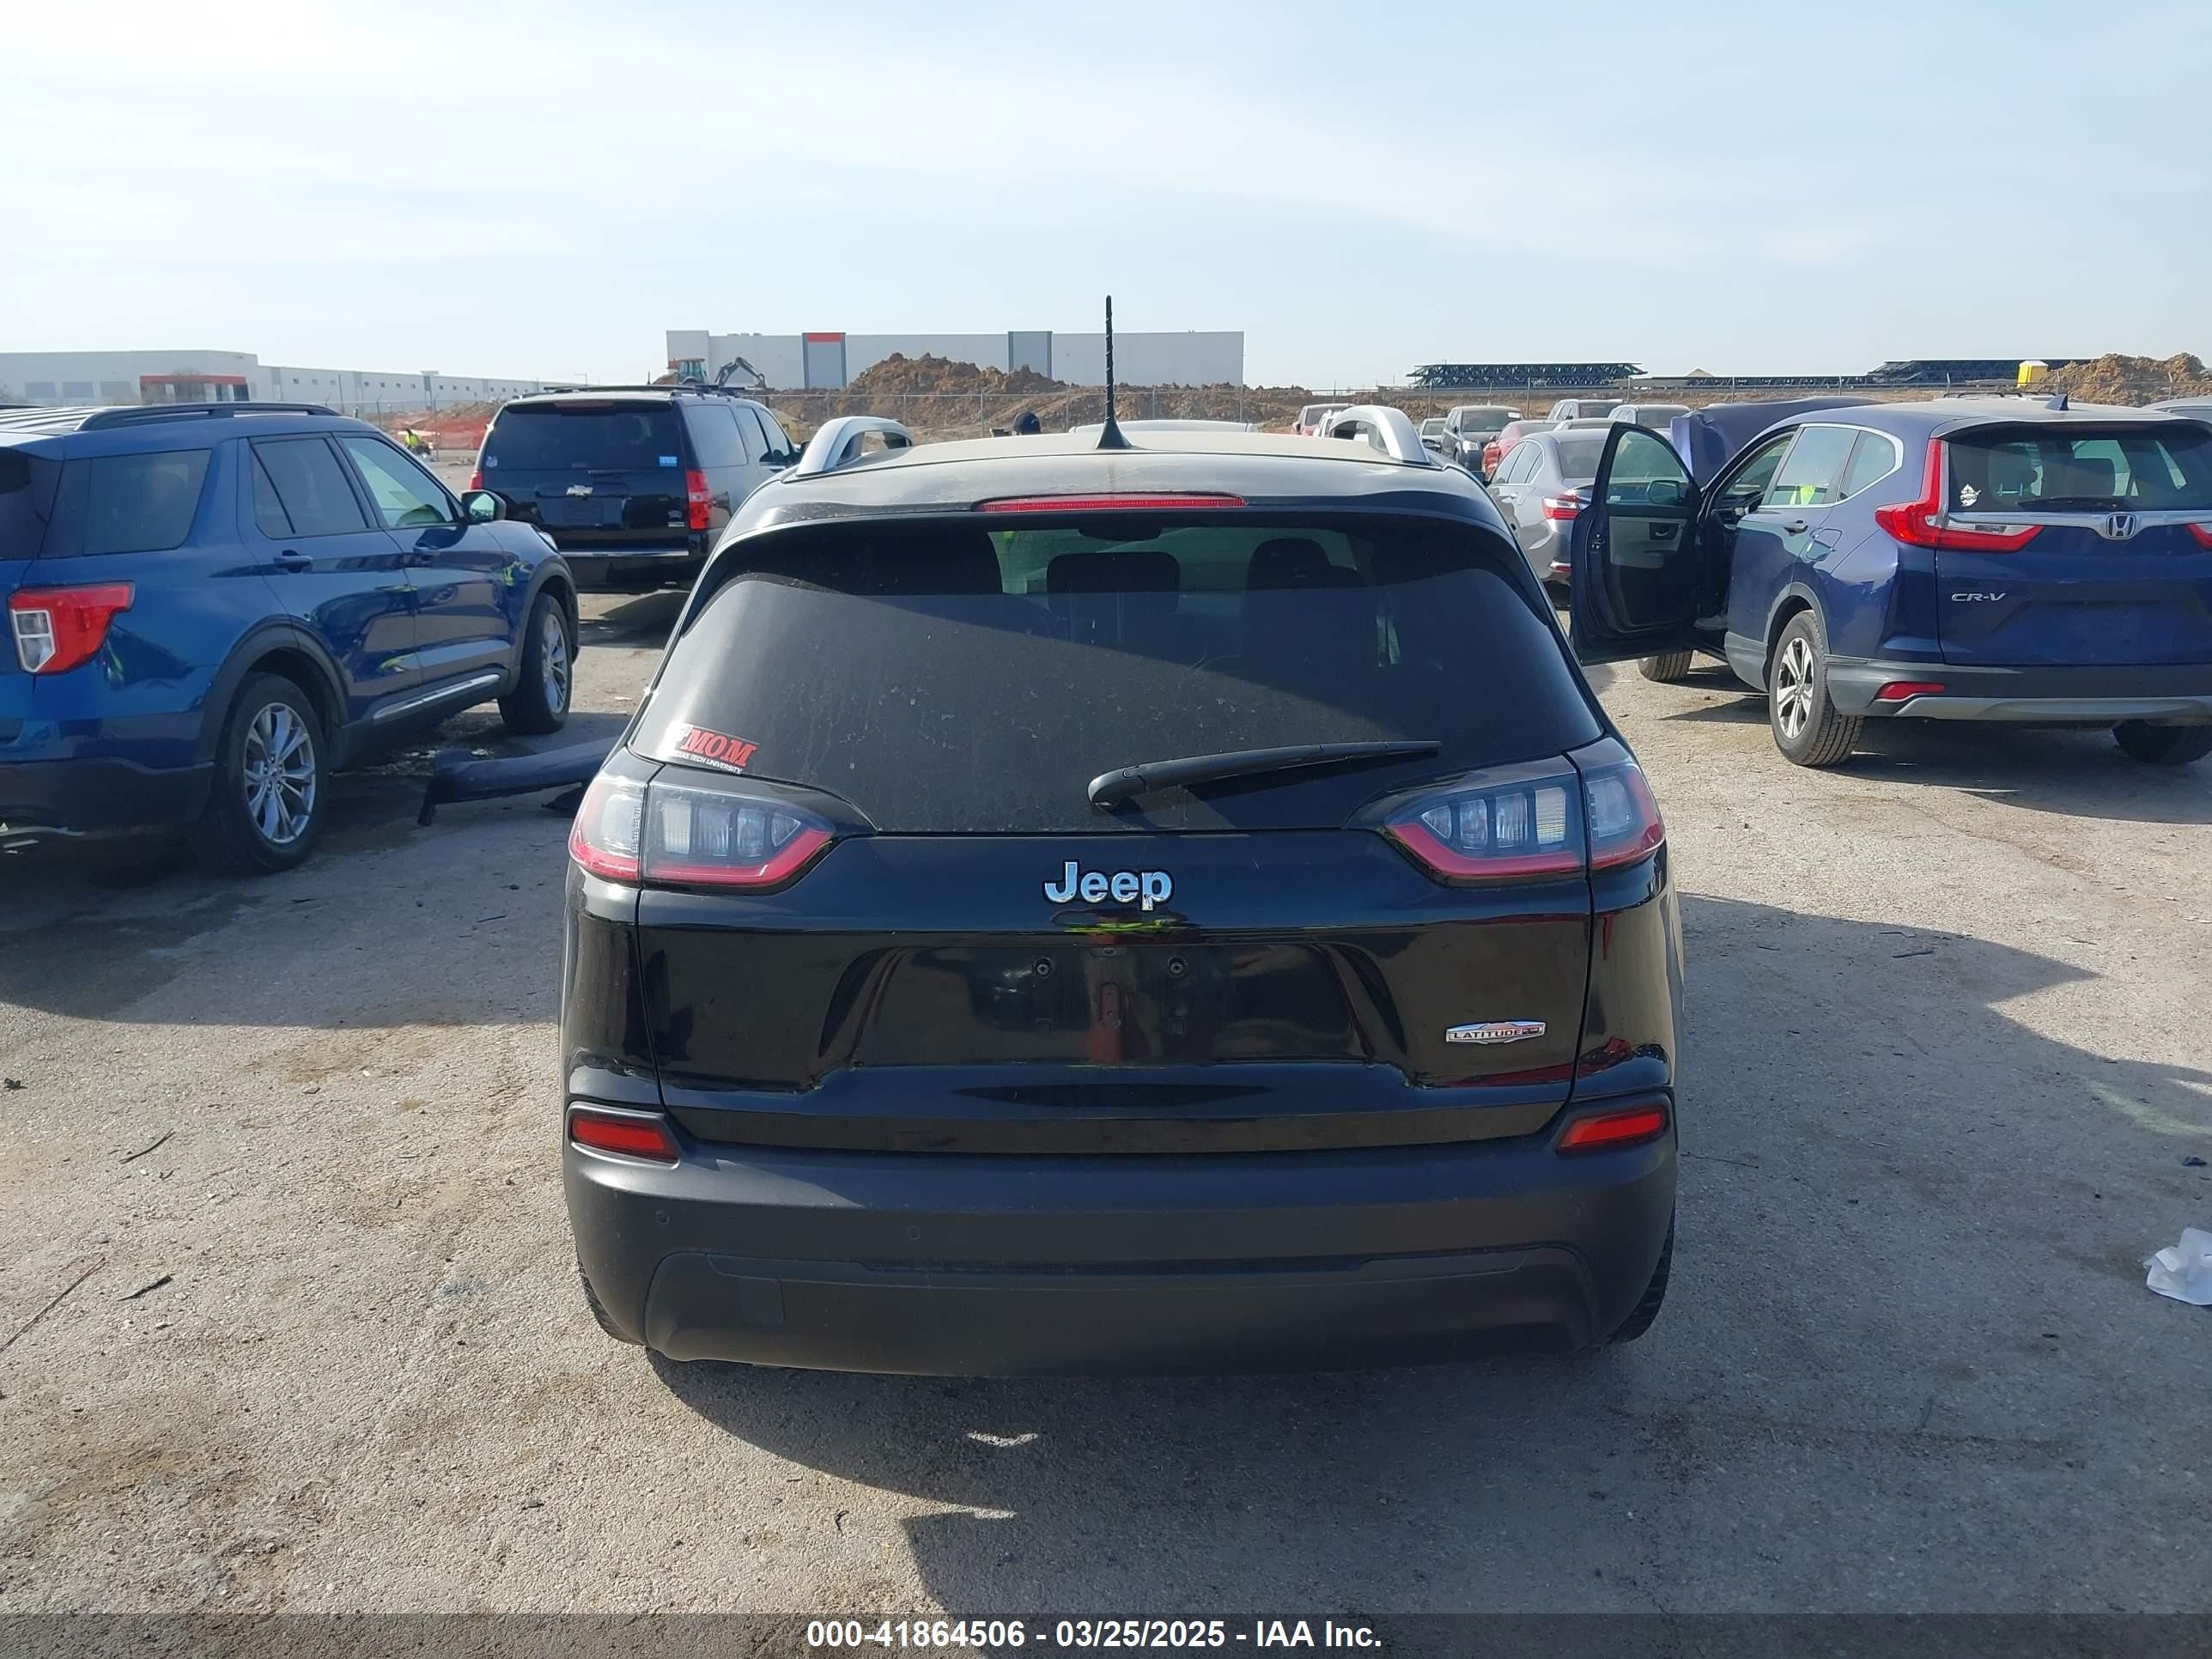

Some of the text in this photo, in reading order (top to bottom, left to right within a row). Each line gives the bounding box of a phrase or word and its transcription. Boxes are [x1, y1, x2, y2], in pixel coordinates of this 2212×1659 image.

[1951, 592, 2007, 602] CR-V
[680, 729, 757, 767] MOM
[690, 754, 707, 764] TECH
[706, 758, 743, 774] UNIVERSITY
[1044, 861, 1172, 911] Jeep
[1454, 1030, 1522, 1039] LATITUDE
